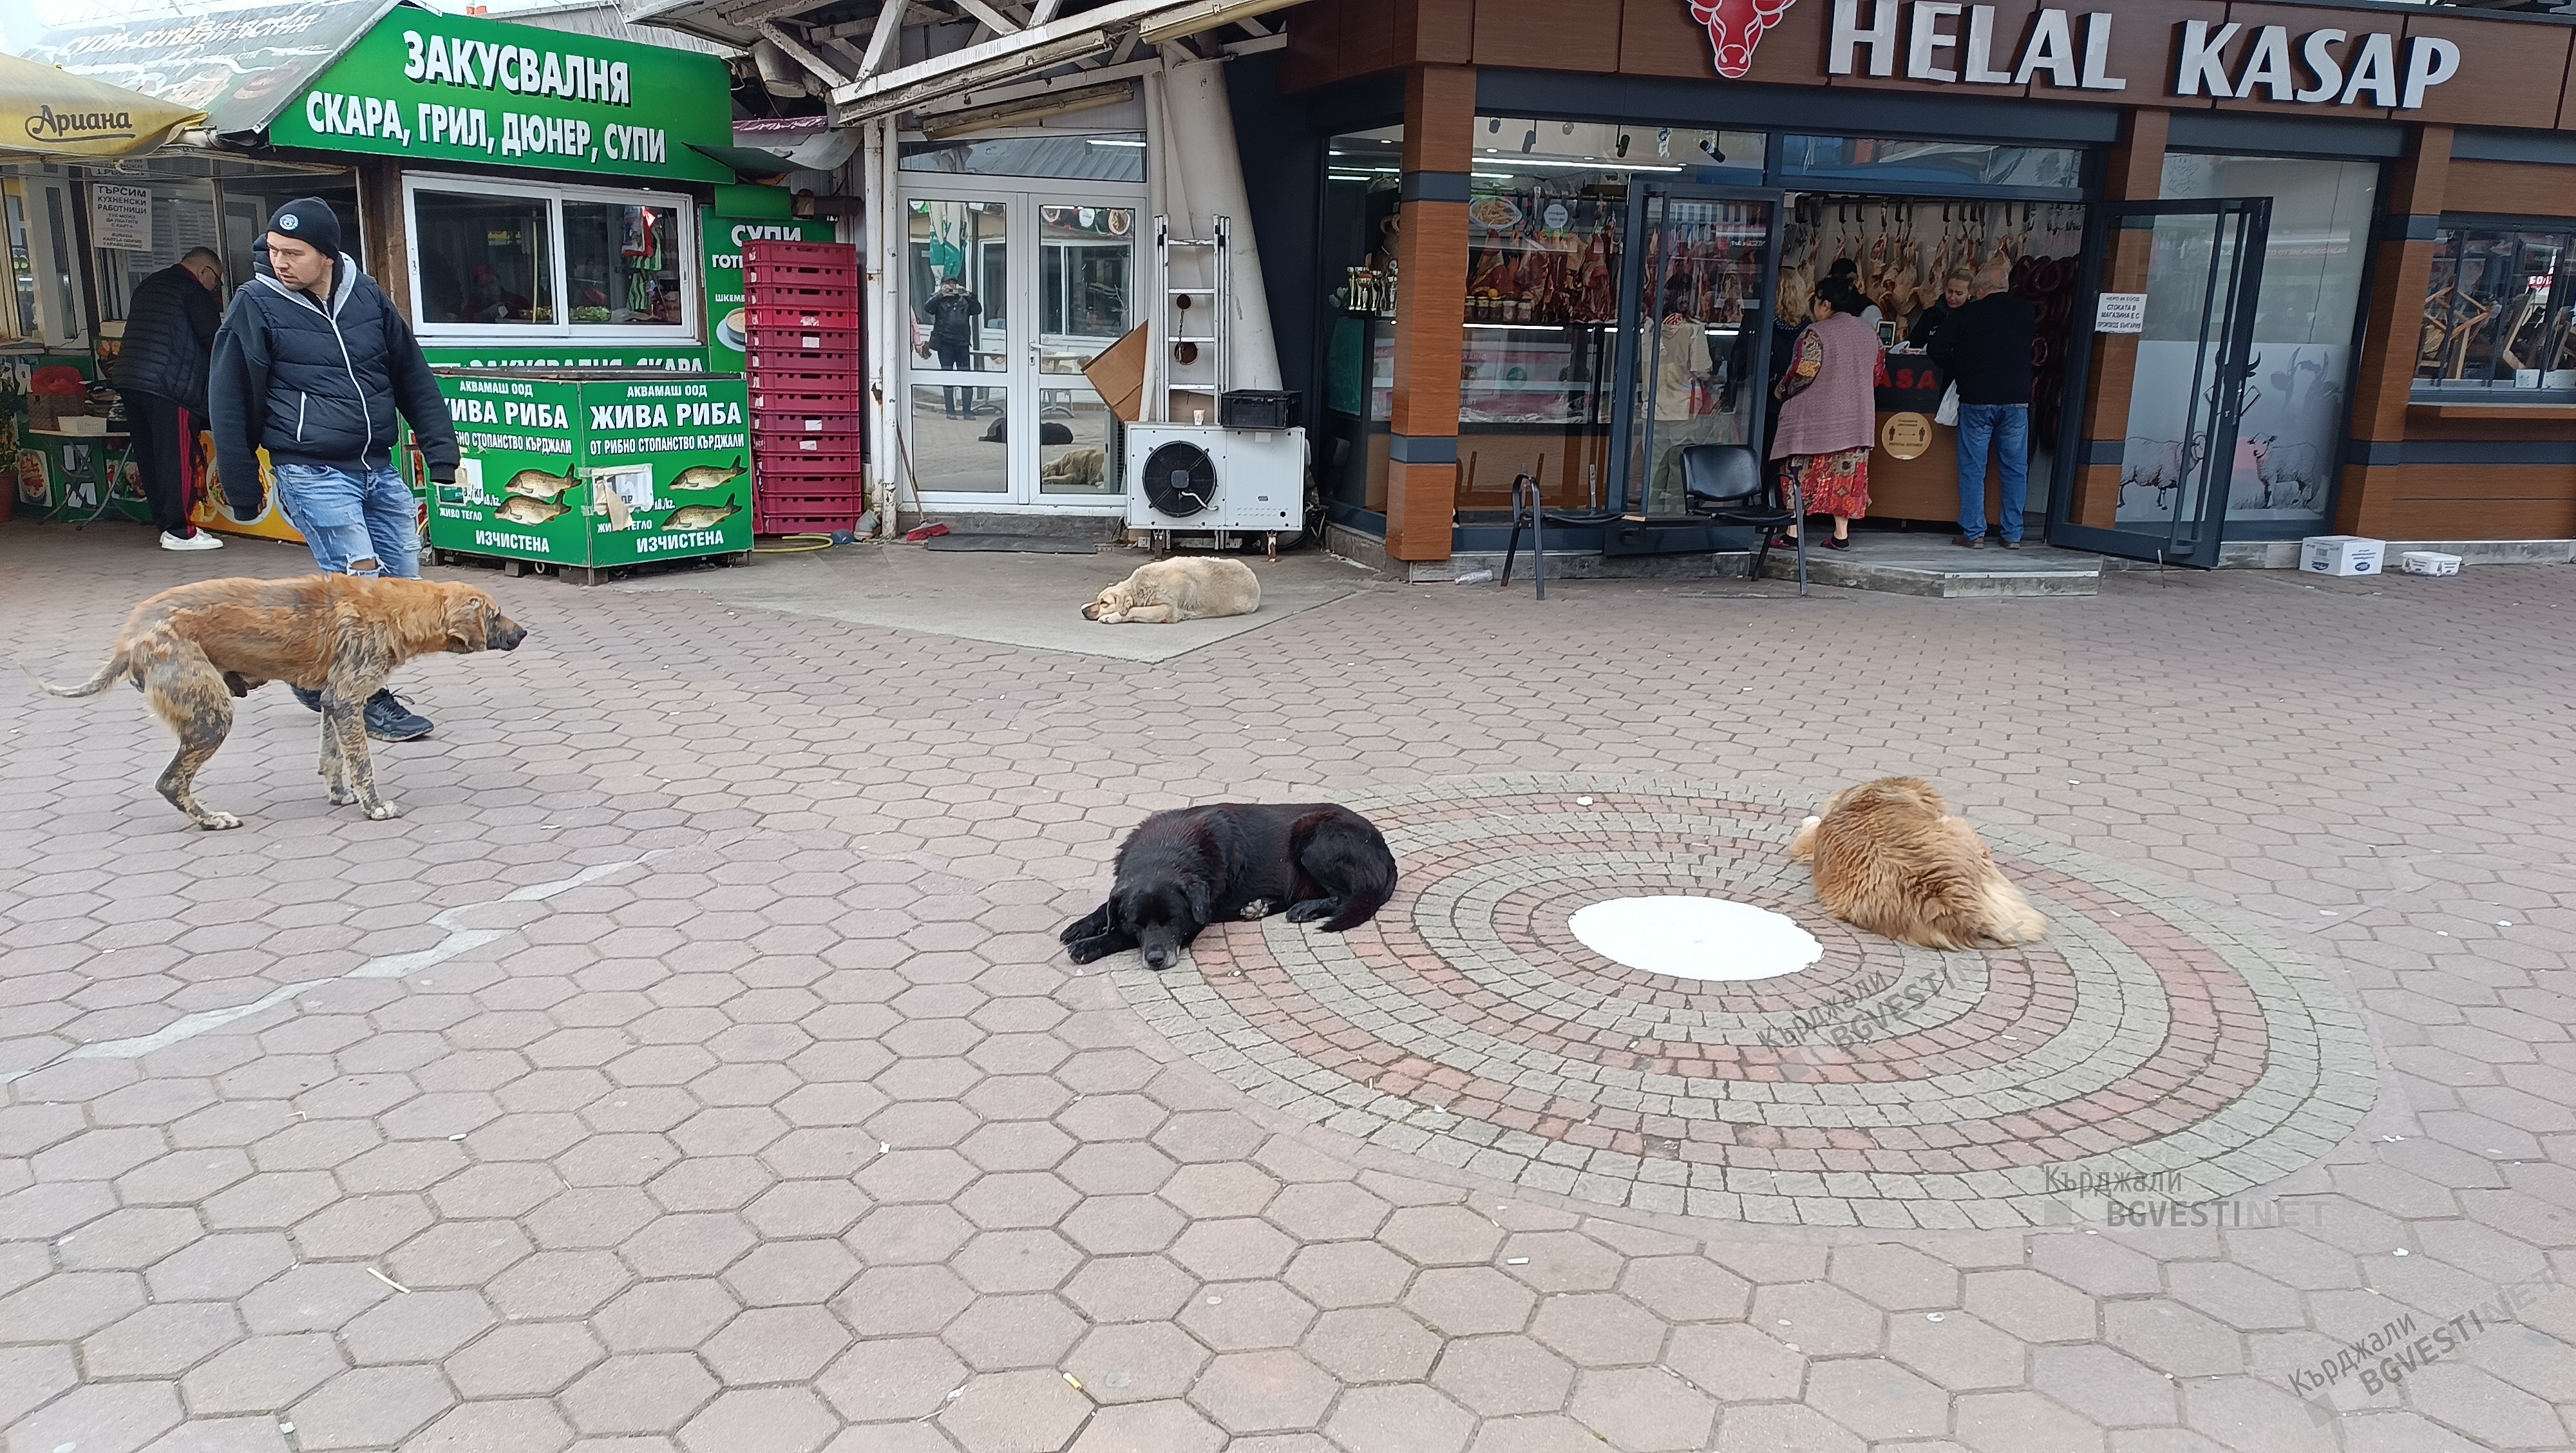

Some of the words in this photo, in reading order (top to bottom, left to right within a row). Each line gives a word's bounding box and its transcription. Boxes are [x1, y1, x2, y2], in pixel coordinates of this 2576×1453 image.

[1830, 0, 2126, 90] HELAL
[2177, 20, 2460, 108] KASAP
[403, 30, 629, 105] ЗАКУСВАЛНЯ
[26, 105, 135, 142] Ариана
[307, 91, 410, 146] СКАРА,
[418, 103, 495, 154] ГРИЛ,
[502, 112, 598, 163] ДЮНЕР,
[605, 123, 666, 163] СУПИ
[97, 186, 146, 198] ТЪРСИМ
[97, 196, 146, 206] КУХНЕНСКИ
[97, 204, 147, 214] РАБОТНИЦИ
[460, 381, 509, 394] АКВАМАШ
[511, 383, 533, 398] ООД
[627, 385, 681, 397] АКВАМАШ
[685, 385, 707, 397] ООД
[444, 398, 498, 424] ИВА
[505, 401, 569, 429] РИБА
[590, 404, 668, 430] ЖИВА
[676, 403, 742, 426] РИБА
[472, 433, 523, 450] СТОПАНСТВО
[526, 436, 572, 455] КЪРДЖАЛИ
[590, 440, 602, 455] ОТ
[604, 439, 635, 454] РИБНО
[638, 435, 694, 453] СТОПАНСТВО
[697, 433, 744, 451] КЪРДЖАЛИ
[439, 508, 460, 518] ЖИВО
[461, 510, 482, 521] ТЕГЛО
[475, 530, 550, 553] ИЗЧИСТЕНА
[636, 530, 724, 553] ИЗЧИСТЕНА
